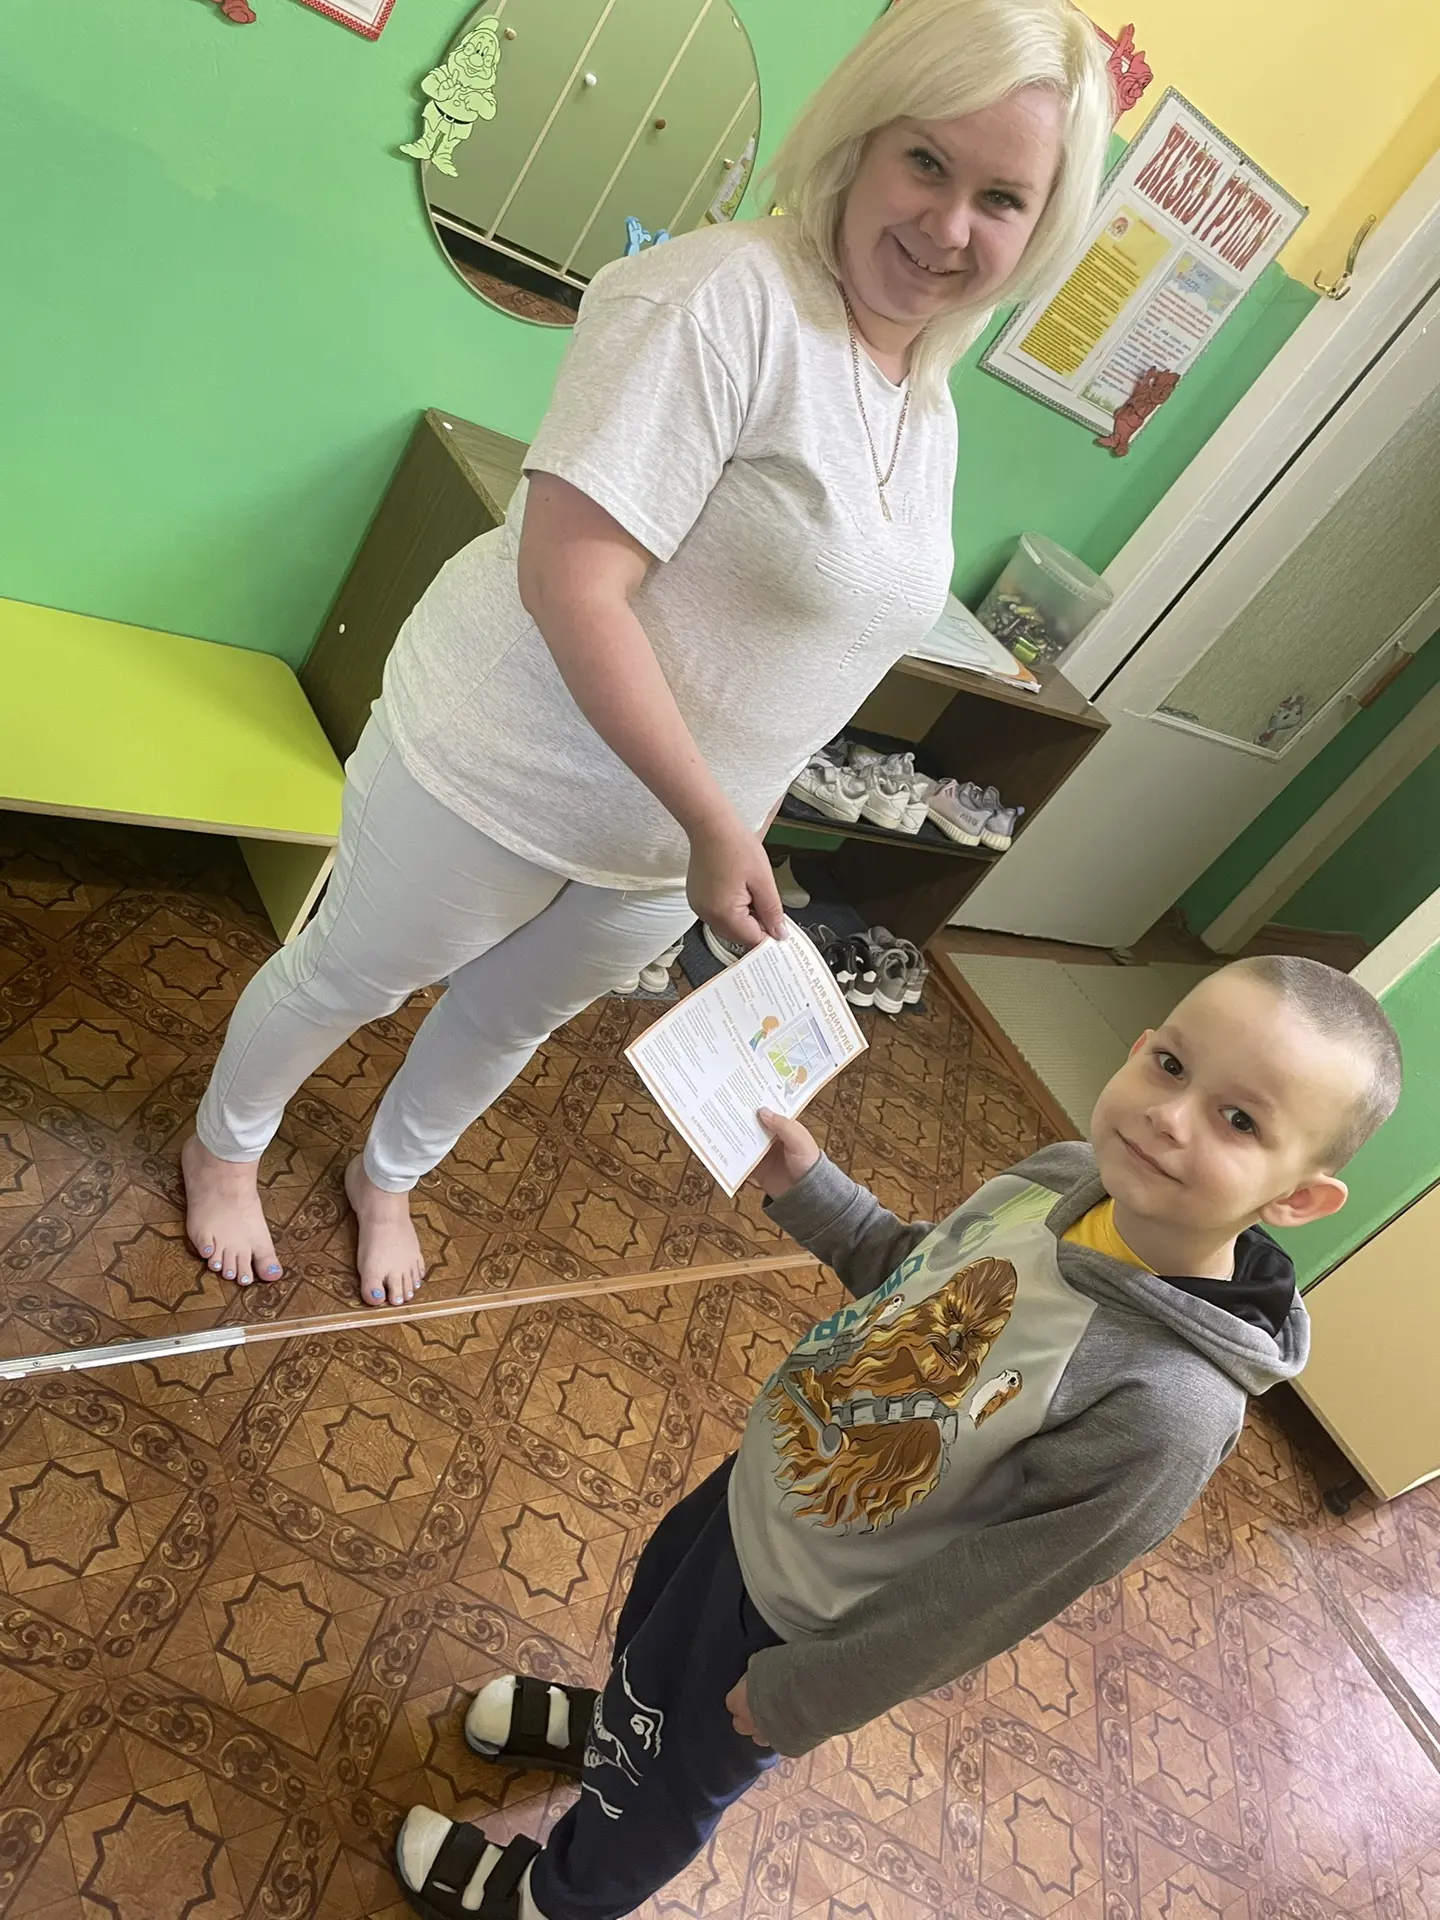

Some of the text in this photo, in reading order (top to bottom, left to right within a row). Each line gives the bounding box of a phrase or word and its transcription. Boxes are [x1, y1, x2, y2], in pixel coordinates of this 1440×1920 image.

[1134, 122, 1282, 271] ЖИЗНЬ ГРУППЫ
[789, 935, 815, 976] АМЯТКА
[812, 977, 828, 998] ДЛЯ
[825, 999, 855, 1054] РОДИТЕЛЕЙ
